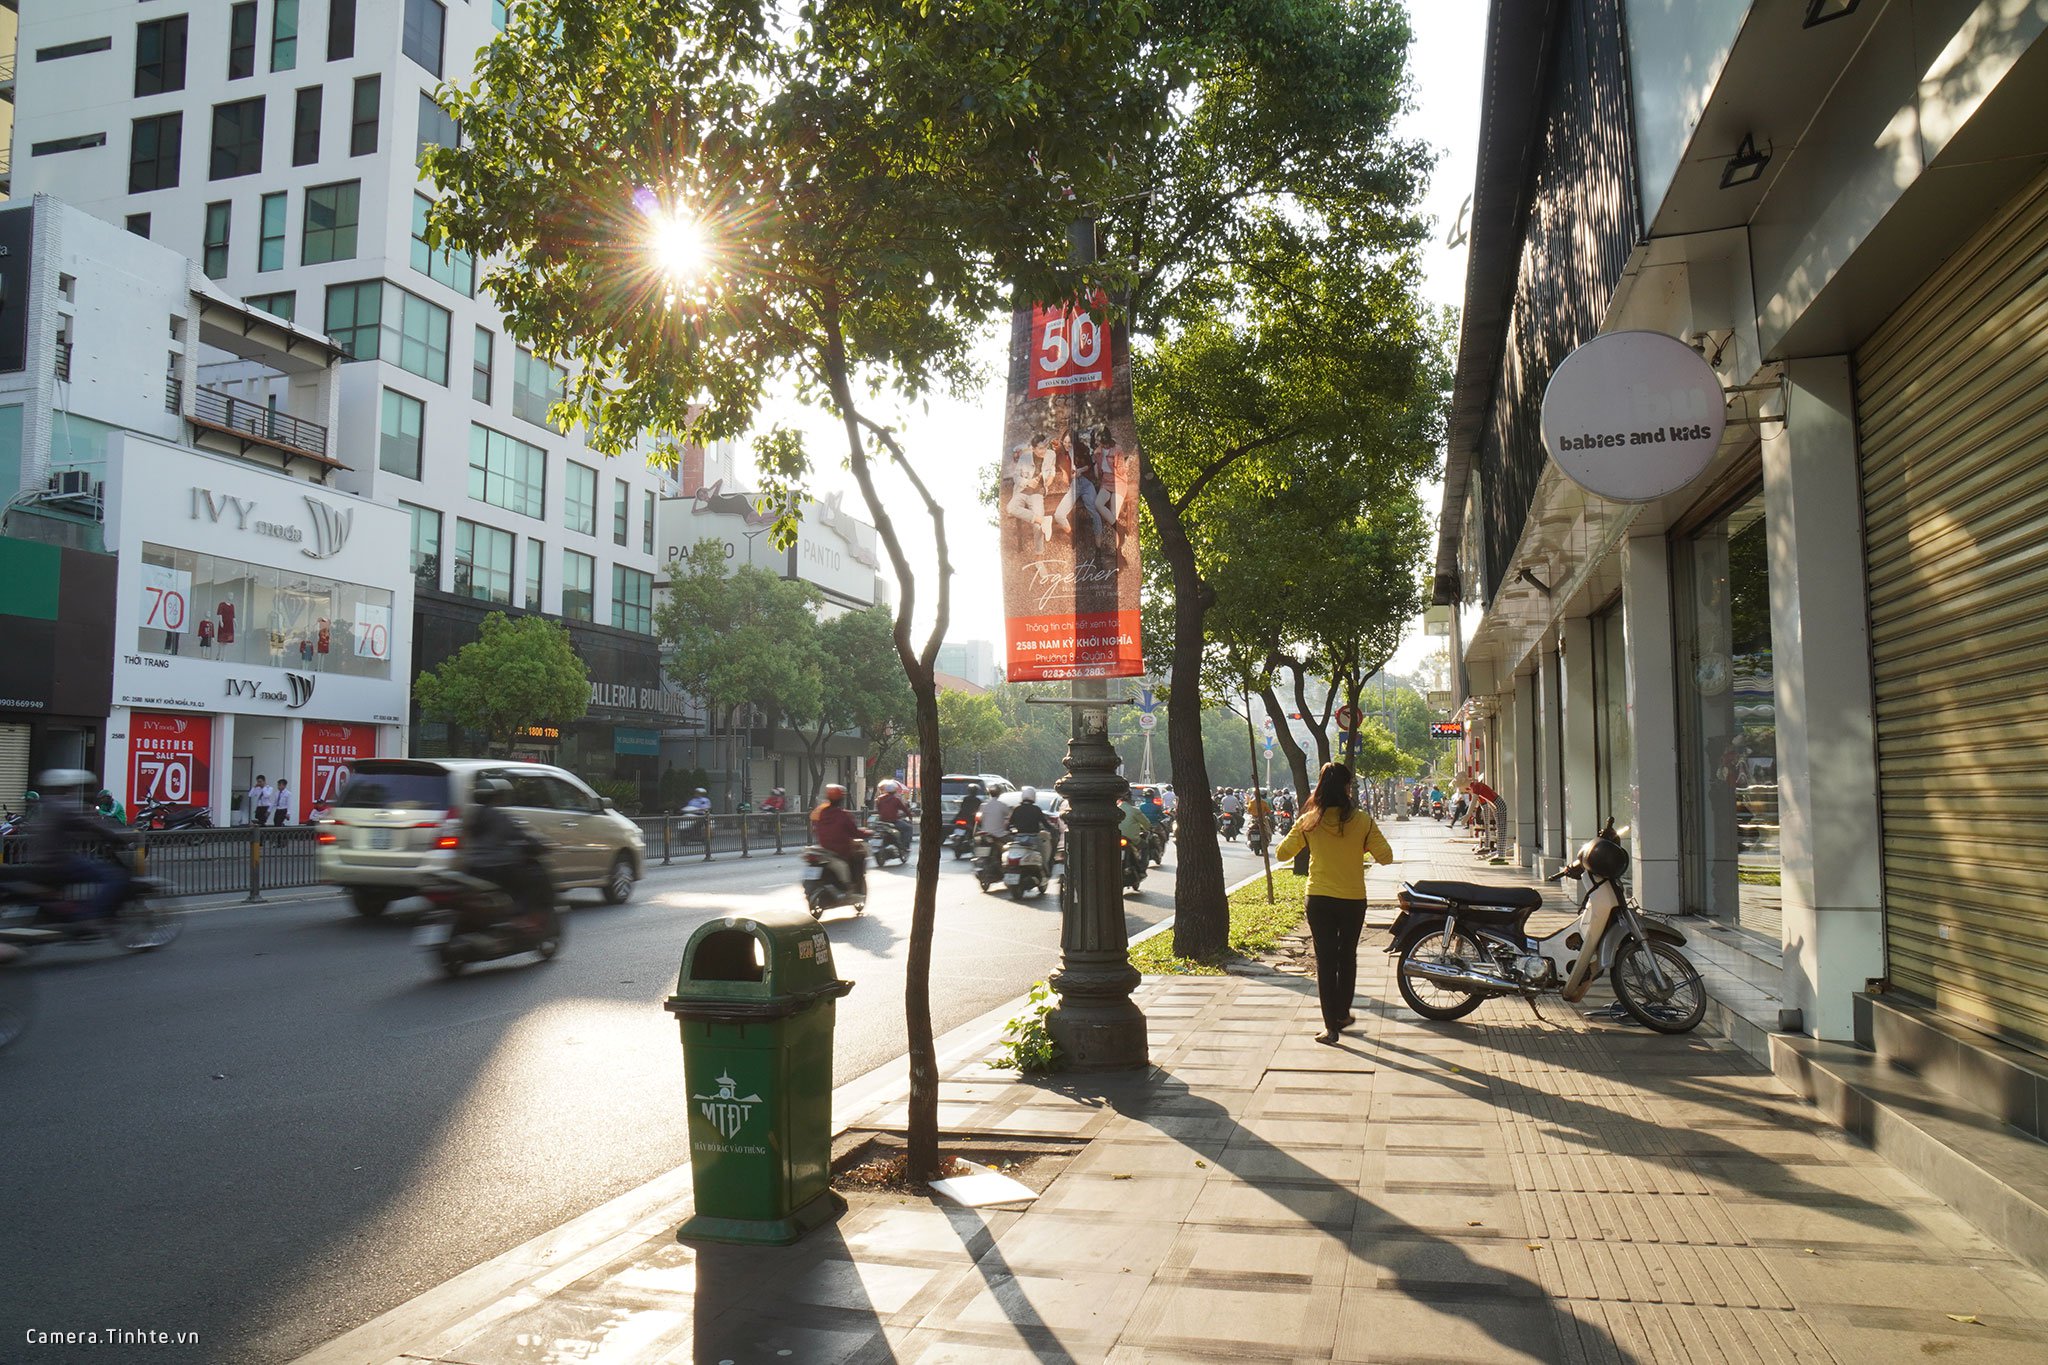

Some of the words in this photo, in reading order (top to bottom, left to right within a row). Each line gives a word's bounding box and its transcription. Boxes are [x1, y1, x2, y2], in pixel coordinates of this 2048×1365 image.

[1559, 431, 1625, 451] babies
[1630, 428, 1666, 445] and
[1669, 425, 1712, 442] kids
[191, 486, 257, 530] IVY
[803, 538, 841, 572] PANTIO
[1022, 556, 1120, 610] Together
[1025, 623, 1049, 633] Thông
[1050, 623, 1059, 631] tin
[1061, 622, 1074, 631] chi
[1016, 641, 1038, 650] 258B
[1039, 640, 1060, 649] NAM
[1062, 636, 1075, 648] KỲ
[1076, 635, 1100, 647] KHỞI
[1102, 633, 1133, 646] NGHĨA
[143, 657, 169, 668] TRANG
[1035, 653, 1068, 664] Phường
[1069, 653, 1075, 661] 8
[1081, 650, 1106, 661] Quận
[1107, 651, 1113, 659] 3
[226, 678, 262, 698] IVY
[0, 699, 15, 707] 903
[143, 720, 160, 730] IVY
[529, 726, 543, 737] 1800
[136, 738, 194, 751] TOGETHER
[313, 744, 357, 755] TOGETHER
[155, 752, 175, 760] SALE
[701, 1102, 752, 1140] MTĐT
